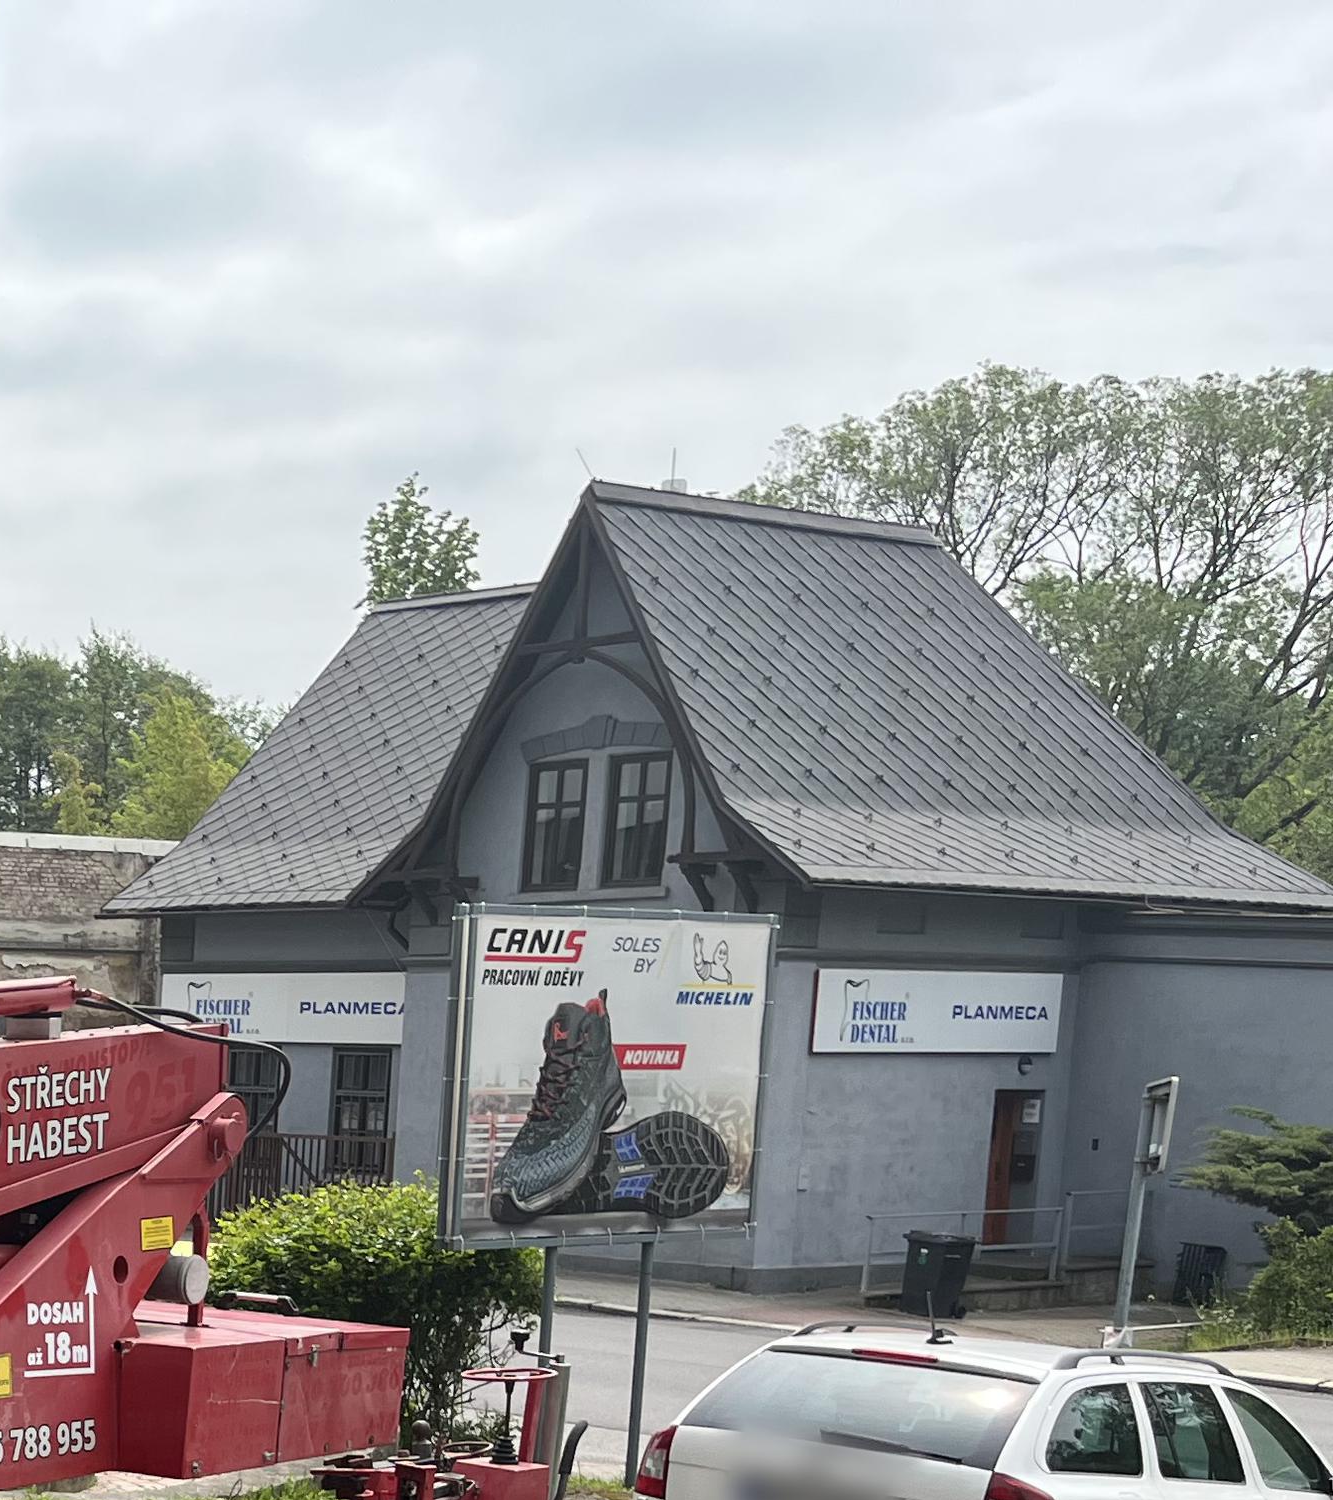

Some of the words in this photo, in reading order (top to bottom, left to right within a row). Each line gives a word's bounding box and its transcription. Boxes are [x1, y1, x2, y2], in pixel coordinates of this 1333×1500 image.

[483, 928, 587, 964] CANIS
[612, 937, 662, 953] SOLES
[633, 958, 657, 973] BY
[481, 966, 542, 986] PRACOVNÍ
[543, 967, 585, 987] ODĚVY
[196, 999, 251, 1015] FISCHER
[675, 991, 753, 1006] MICHELIN
[852, 1001, 907, 1021] FISCHER
[952, 1005, 1049, 1020] PLANMECA
[850, 1024, 898, 1043] DENTAL
[623, 1049, 680, 1065] NOVINKA
[6, 1066, 112, 1114] STŘECHY
[7, 1112, 110, 1165] HABEST
[26, 1301, 85, 1326] DOSAH
[27, 1347, 44, 1366] až
[10, 1425, 52, 1462] 788
[57, 1418, 96, 1456] 955
